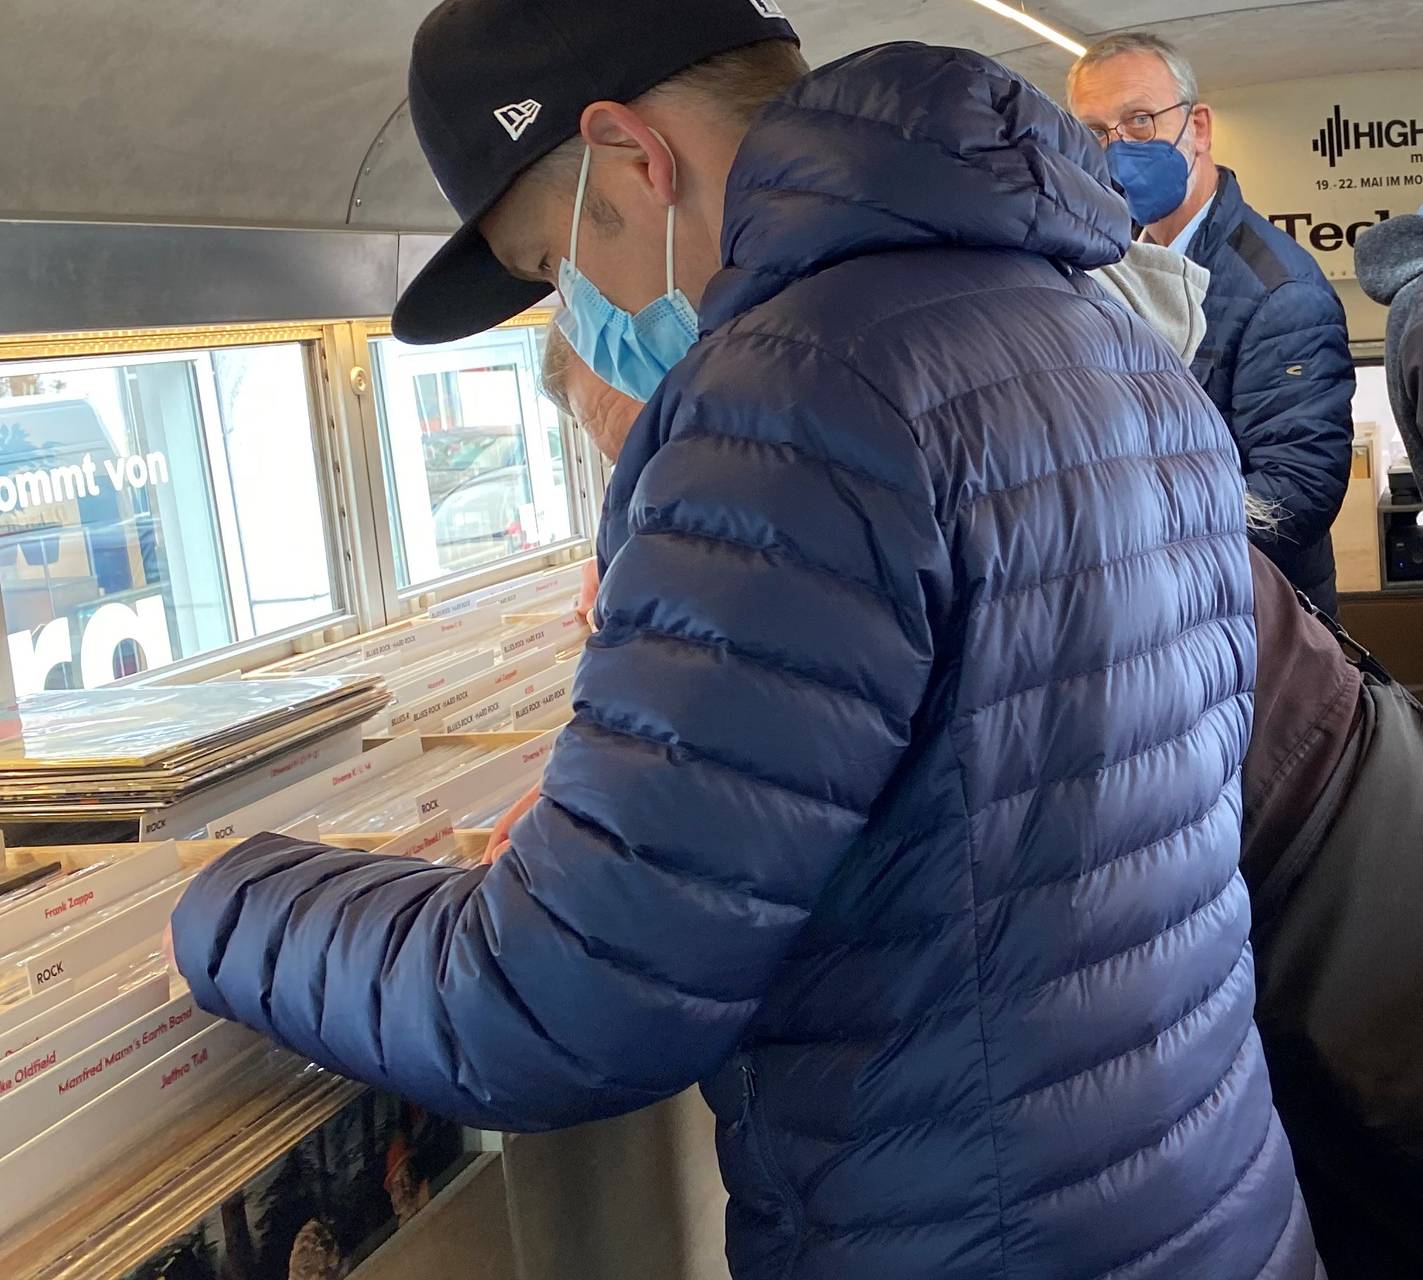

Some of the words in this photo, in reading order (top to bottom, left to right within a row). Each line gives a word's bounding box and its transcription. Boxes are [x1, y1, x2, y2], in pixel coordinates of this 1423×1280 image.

[1360, 176, 1383, 189] MAI
[1386, 175, 1401, 188] IM
[1268, 209, 1390, 252] Tec
[103, 450, 169, 492] von
[421, 799, 440, 814] ROCK
[146, 819, 167, 834] ROCK
[214, 825, 235, 840] ROCK
[44, 901, 67, 919] Frank
[67, 890, 94, 909] Zappa
[36, 960, 65, 985] ROCK
[58, 1057, 102, 1095] Manfred
[104, 1038, 141, 1069] Mann's
[142, 1020, 167, 1045] Earth
[169, 1007, 193, 1030] Band
[15, 1050, 56, 1083] Oldfield
[161, 1063, 190, 1089] Jethro
[191, 1047, 209, 1067] Tull
